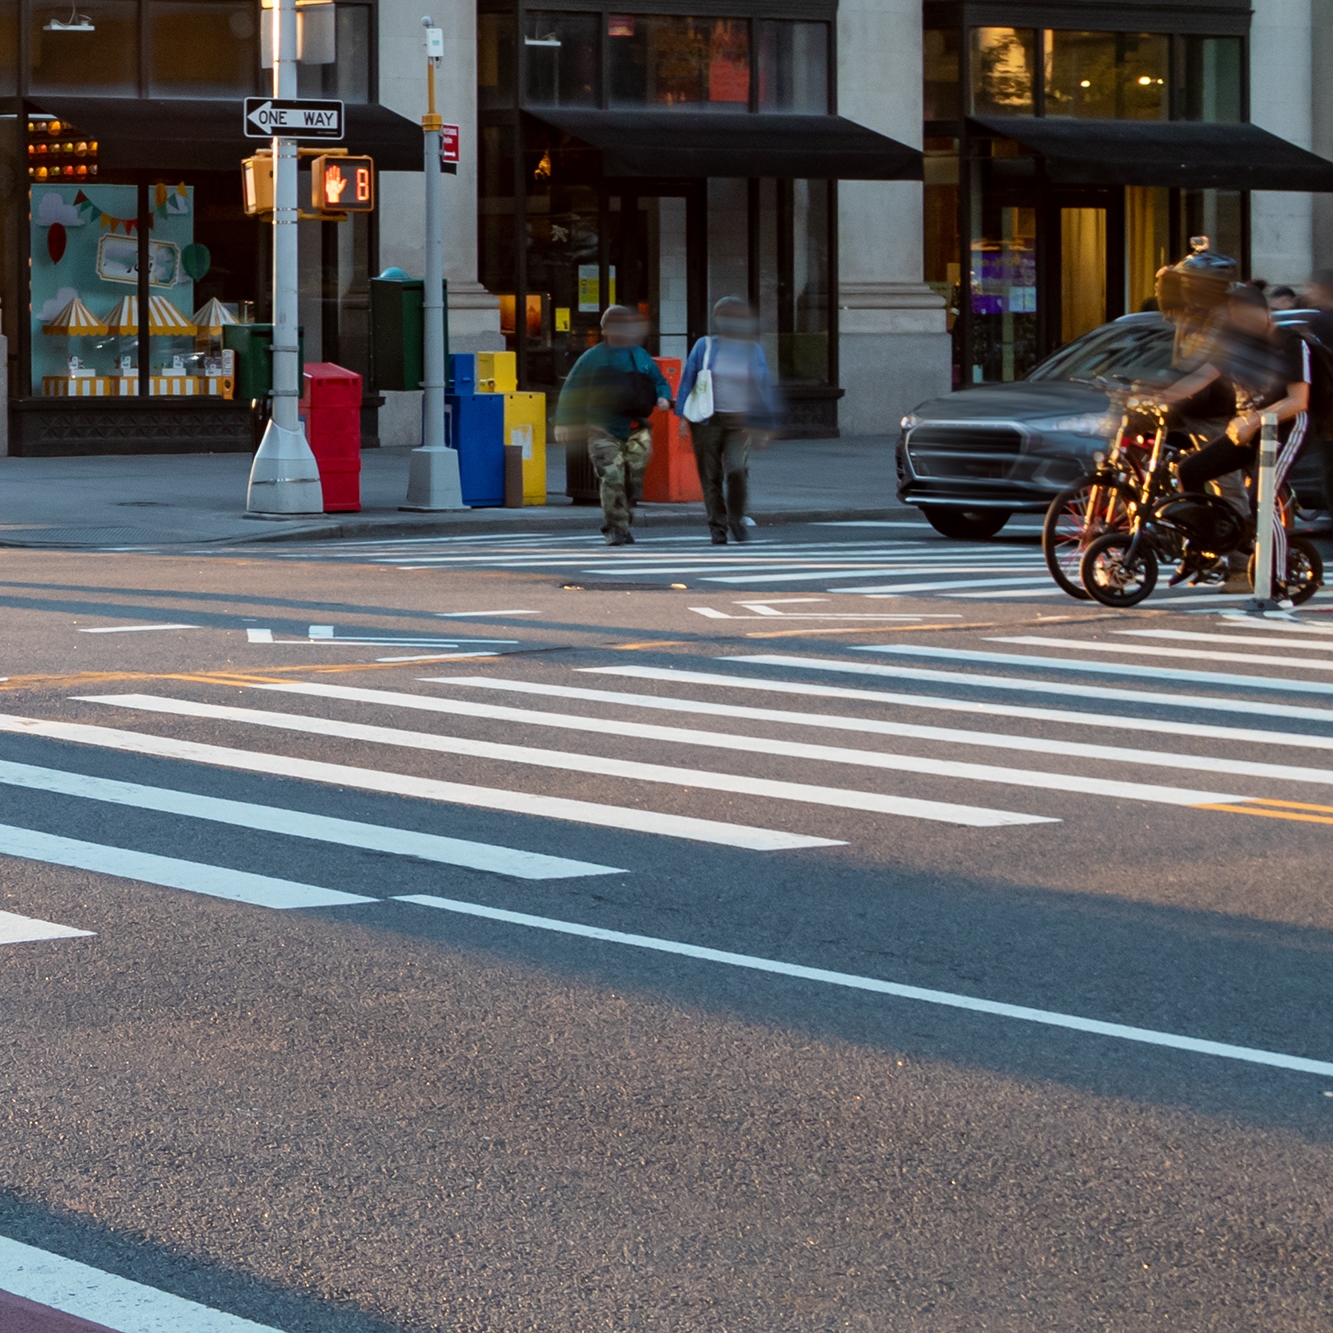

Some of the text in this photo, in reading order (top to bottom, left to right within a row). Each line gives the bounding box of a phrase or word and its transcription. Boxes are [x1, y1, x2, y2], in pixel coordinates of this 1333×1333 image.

[258, 110, 334, 126] ONE WAY
[356, 168, 370, 201] 8
